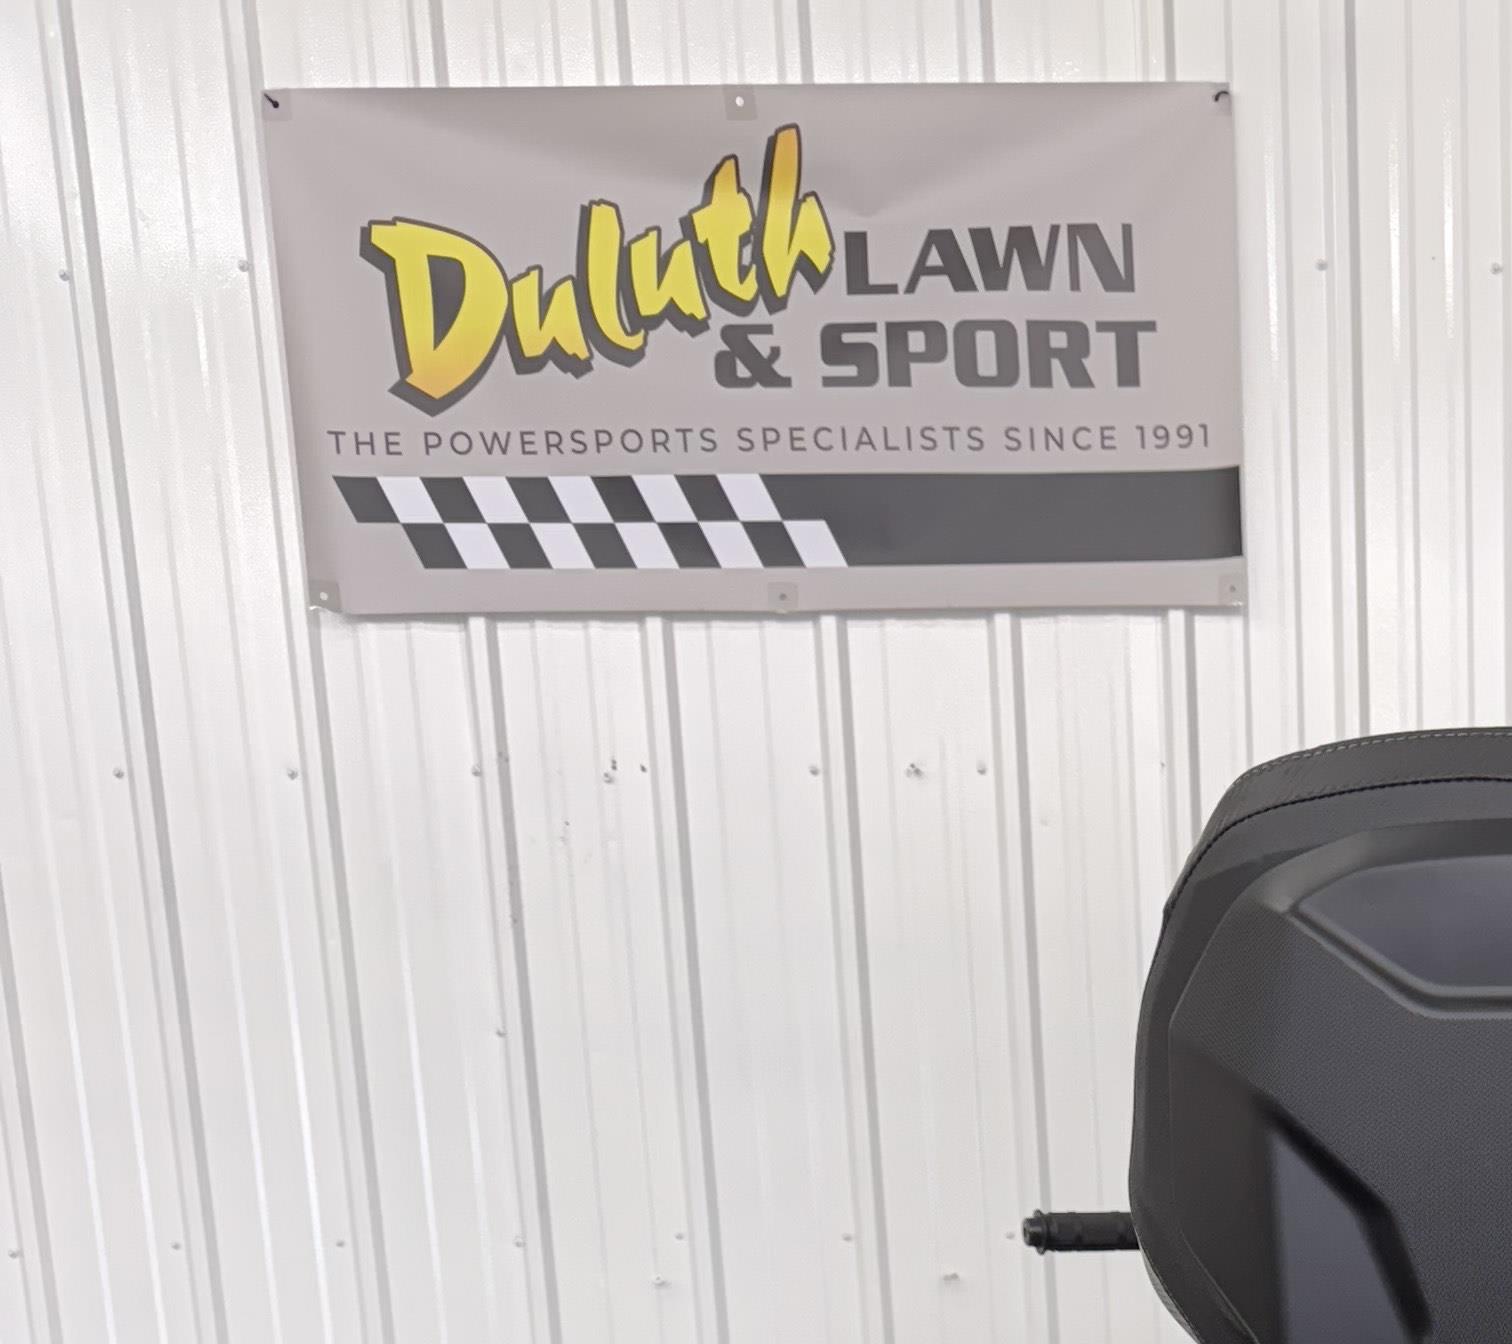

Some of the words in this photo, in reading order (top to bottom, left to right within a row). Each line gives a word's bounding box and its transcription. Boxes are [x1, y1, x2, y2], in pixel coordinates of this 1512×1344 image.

[360, 123, 836, 417] Duluth
[844, 223, 1136, 295] LAWN
[714, 323, 792, 389] &
[820, 319, 1157, 388] SPORT
[327, 430, 403, 456] THE
[423, 427, 718, 456] POWERSPORTS
[736, 425, 986, 453] SPECIALISTS
[1003, 424, 1118, 452] SINCE
[1135, 423, 1210, 450] 1991
